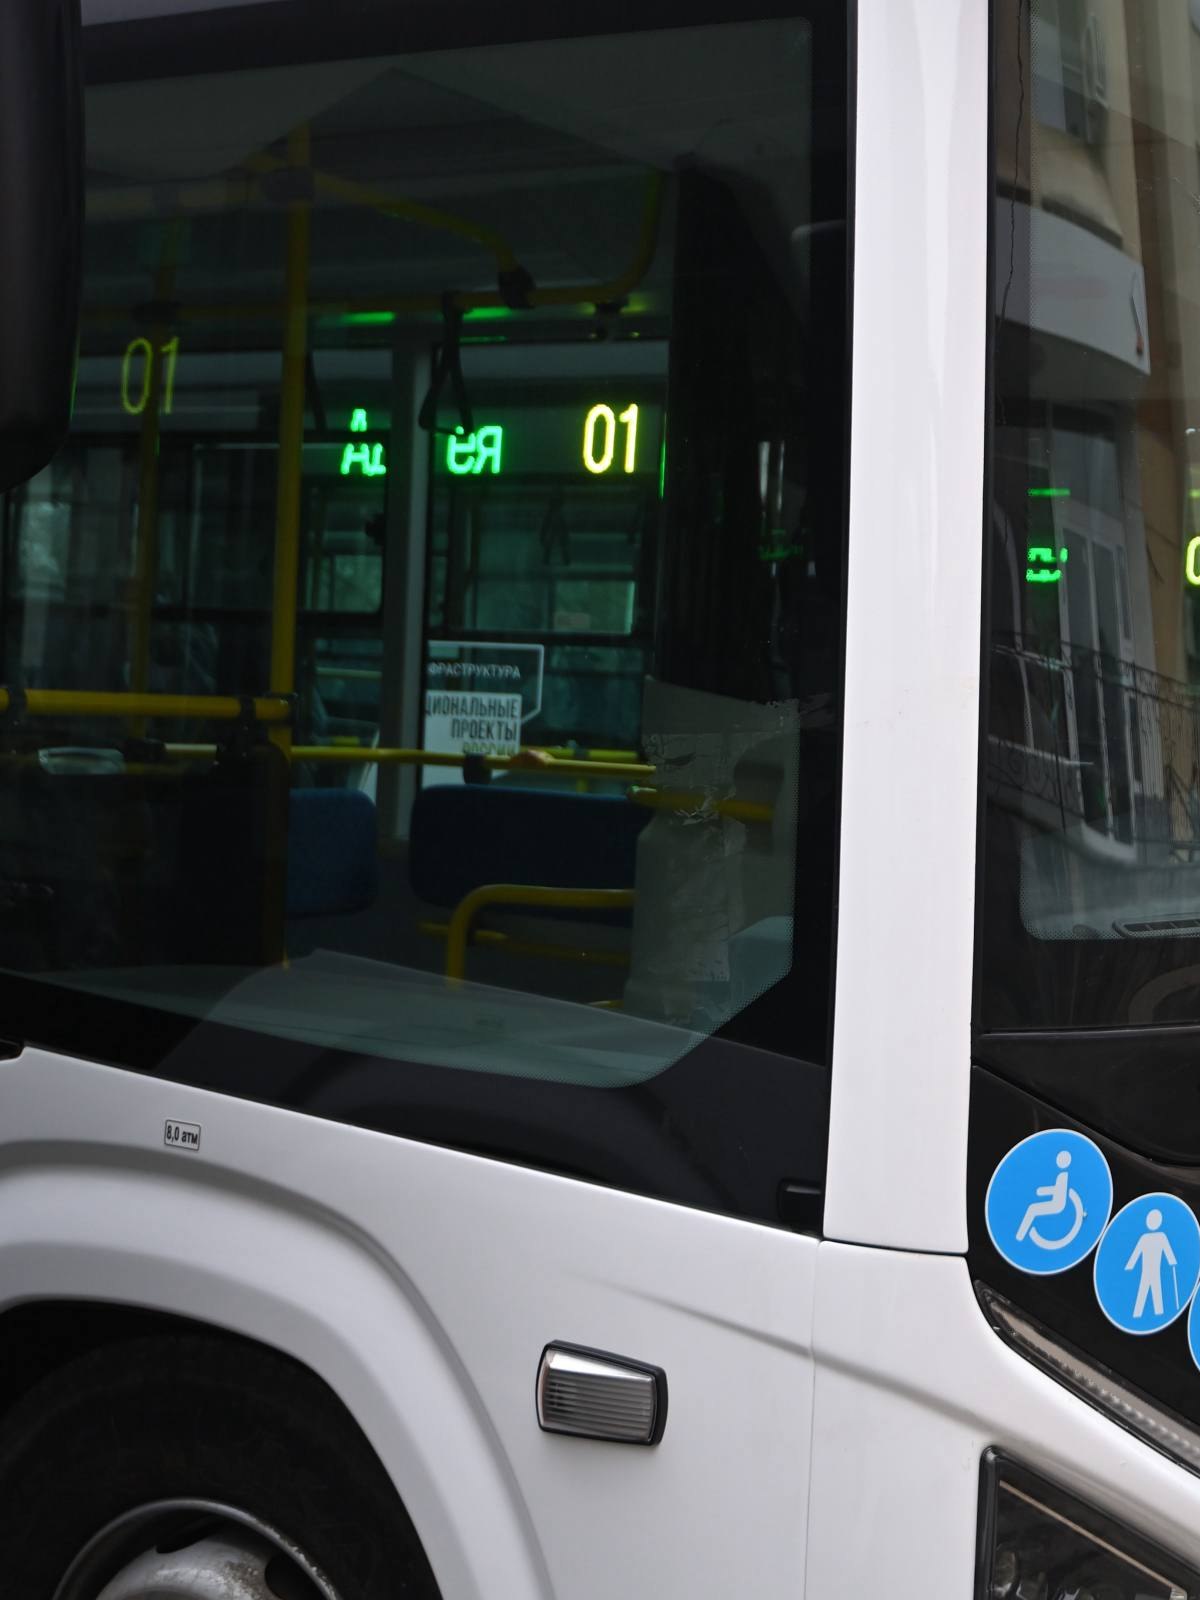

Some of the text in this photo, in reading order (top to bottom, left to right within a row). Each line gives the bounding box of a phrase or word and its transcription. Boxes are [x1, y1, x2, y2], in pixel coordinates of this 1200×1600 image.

[583, 404, 638, 474] 01
[451, 718, 517, 740] ПРОЕКТЫ
[167, 1125, 179, 1142] 8,0
